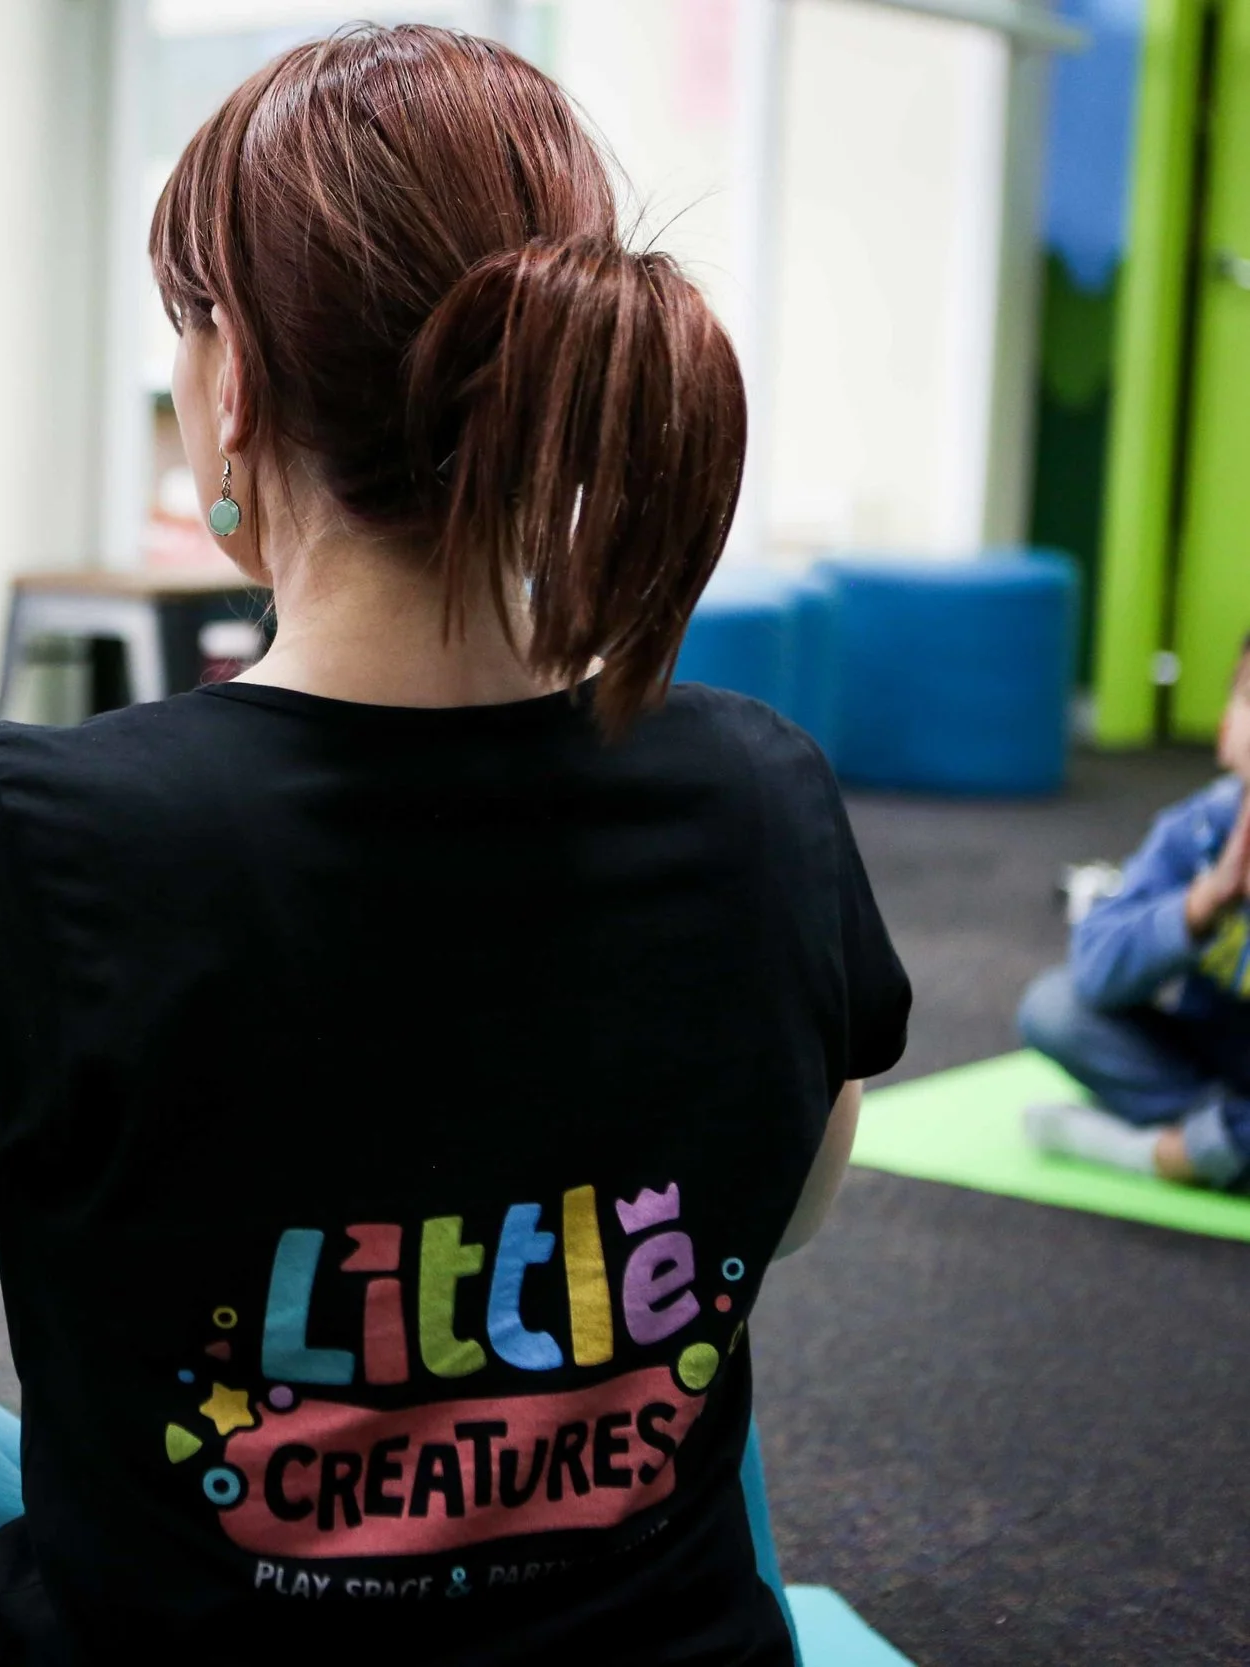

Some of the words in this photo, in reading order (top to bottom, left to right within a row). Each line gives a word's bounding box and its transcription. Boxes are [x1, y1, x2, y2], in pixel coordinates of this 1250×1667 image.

[261, 1182, 701, 1385] Little
[264, 1402, 677, 1532] CREATURES
[253, 1559, 331, 1600] PLAY
[445, 1565, 473, 1599] &
